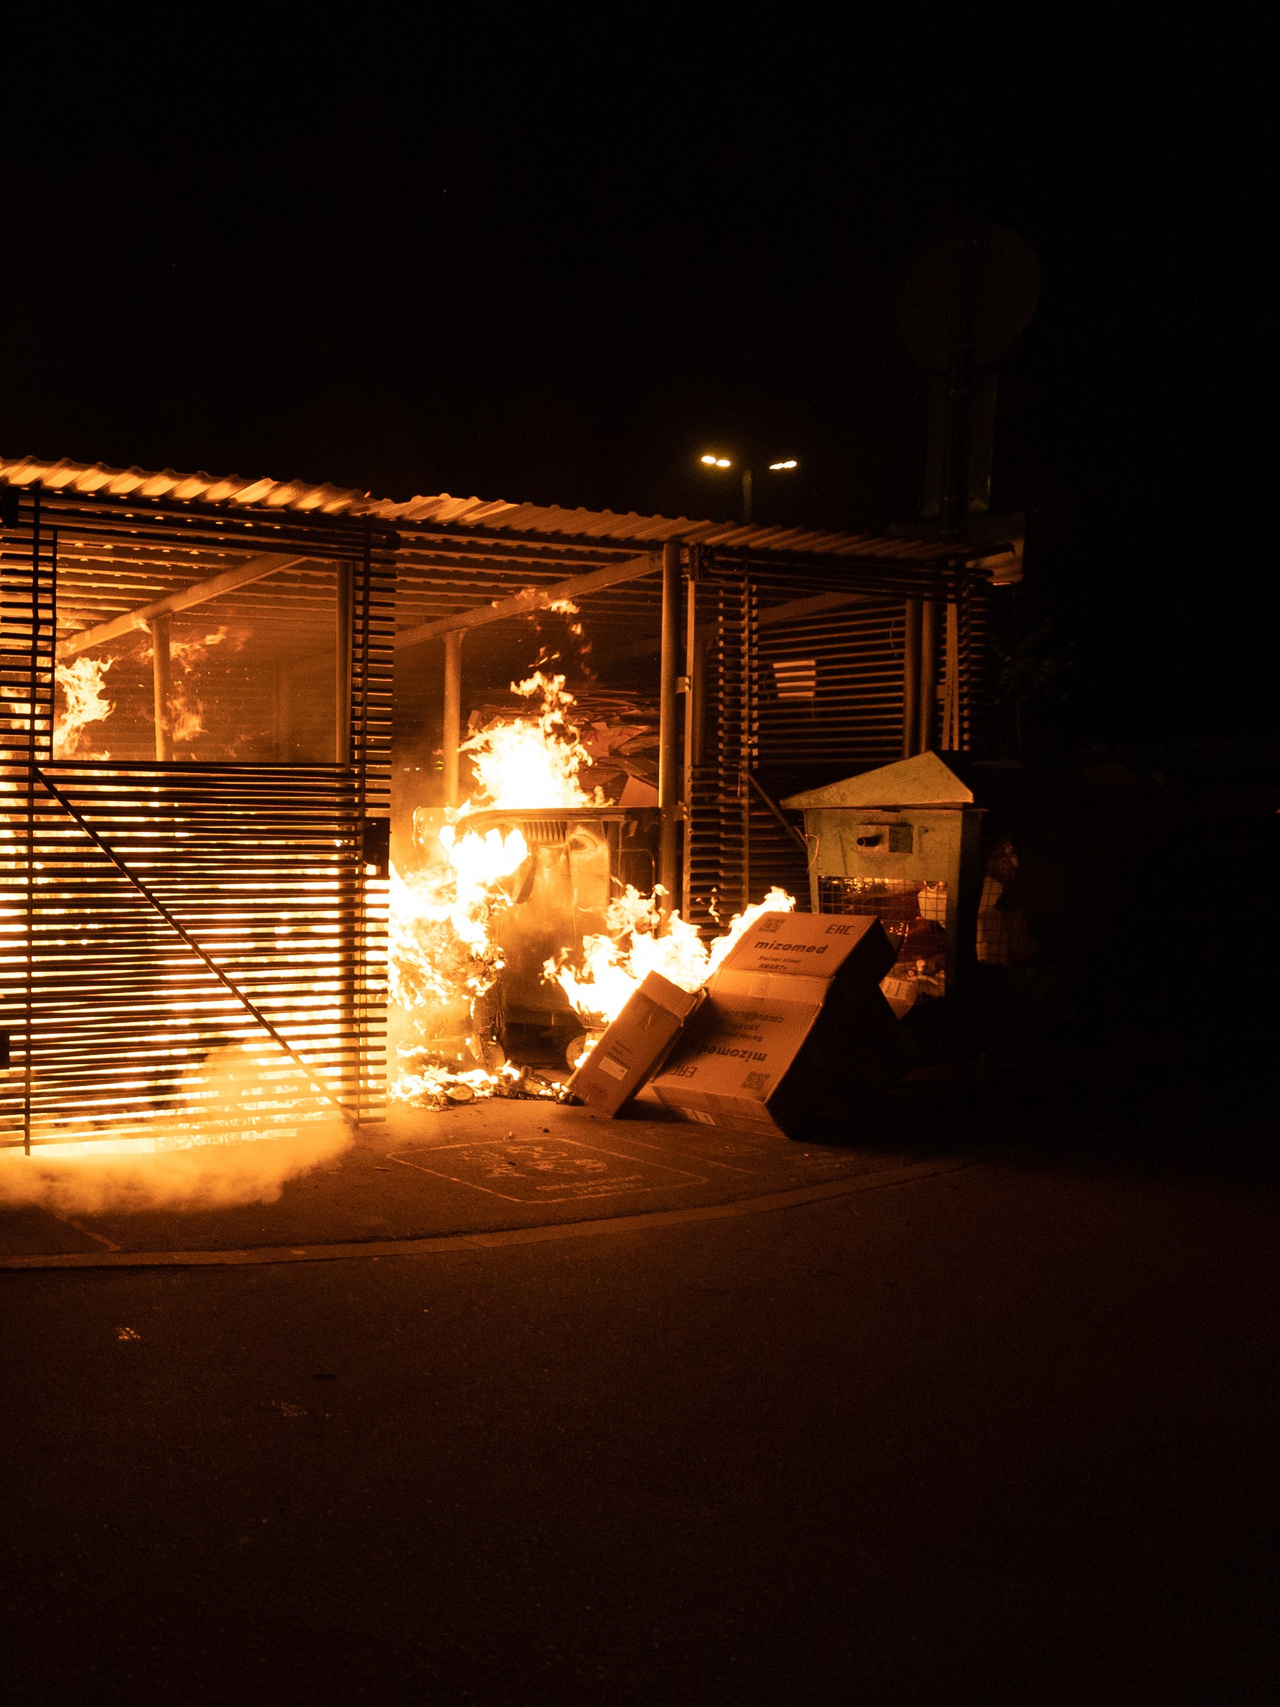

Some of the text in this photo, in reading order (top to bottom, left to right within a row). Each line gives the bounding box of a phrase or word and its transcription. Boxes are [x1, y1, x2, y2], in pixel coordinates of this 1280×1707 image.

[824, 923, 856, 936] EAC
[754, 939, 829, 954] mizomed
[696, 1046, 767, 1062] mizomed
